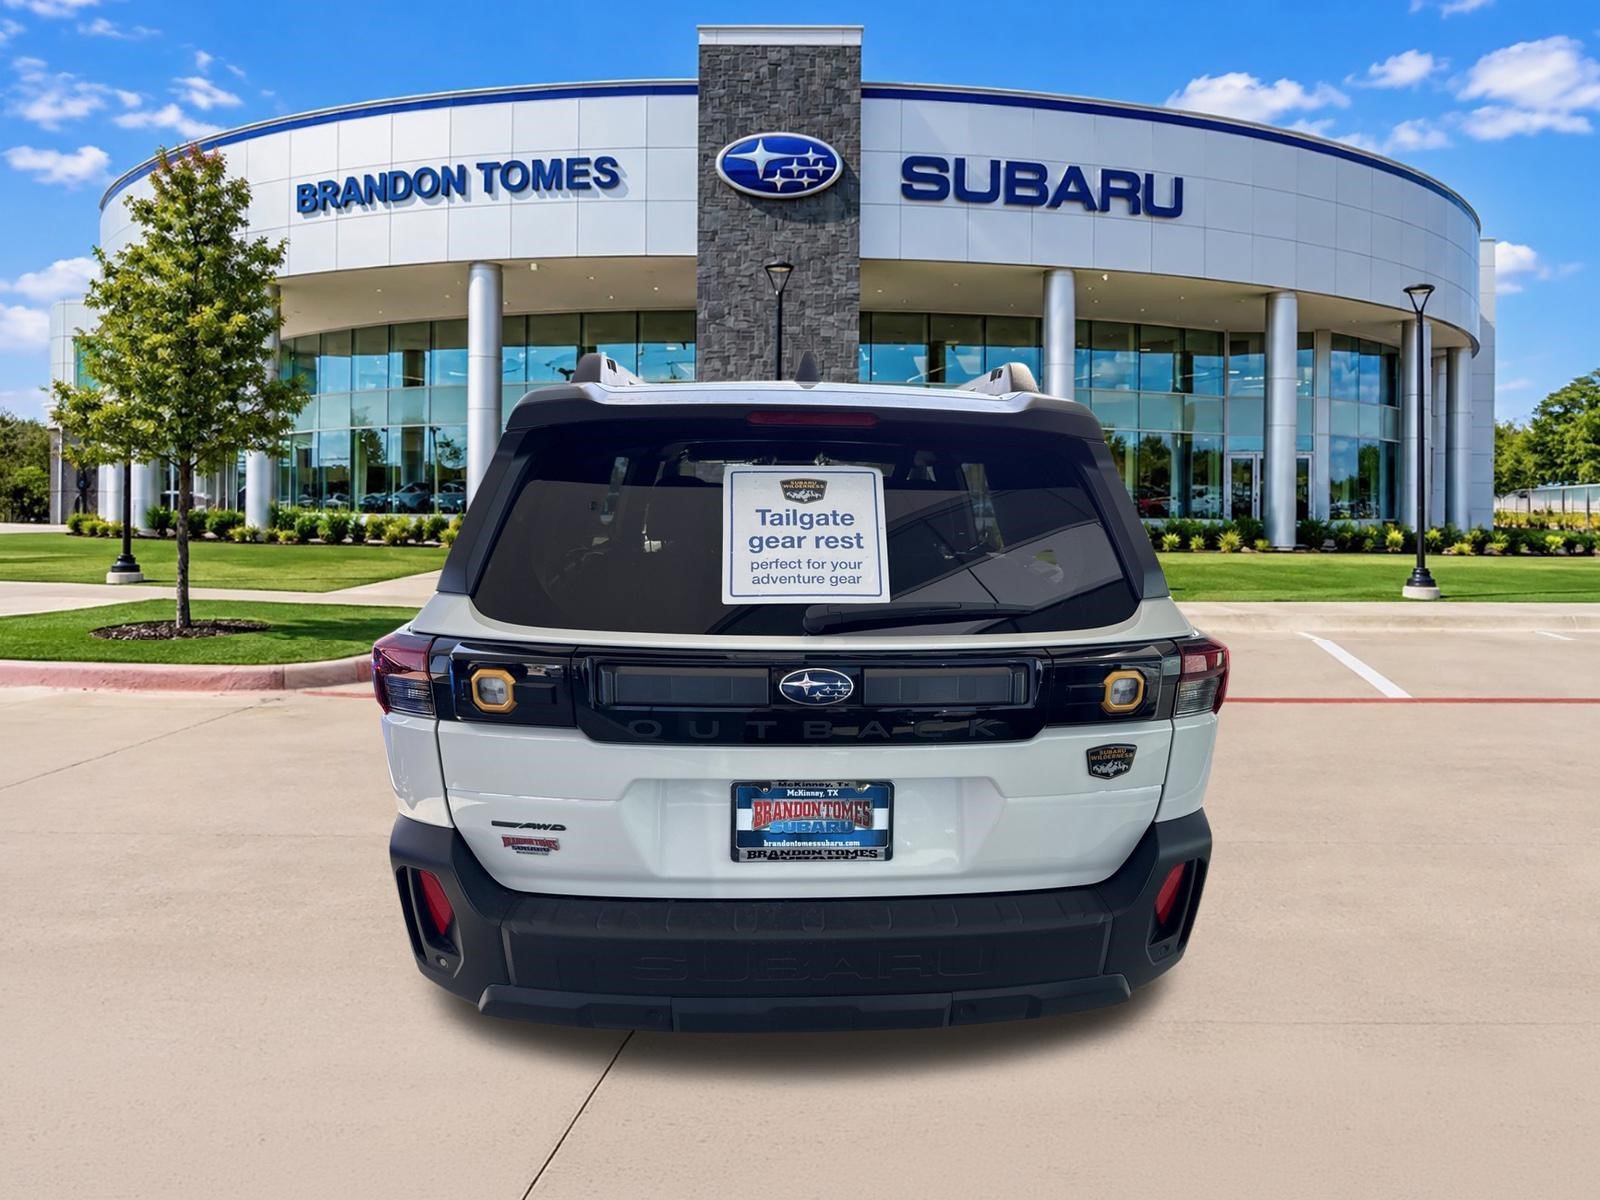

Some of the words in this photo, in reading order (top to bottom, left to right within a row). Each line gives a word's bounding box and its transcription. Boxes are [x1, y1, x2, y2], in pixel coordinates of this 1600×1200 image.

[296, 165, 466, 214] BRANDON
[476, 156, 620, 194] TOMES
[901, 155, 1183, 218] SUBARU
[755, 509, 855, 530] Tailgate
[748, 535, 807, 554] gear
[815, 532, 864, 549] rest
[750, 558, 801, 572] perfect
[807, 559, 827, 570] for
[831, 561, 863, 573] your
[751, 573, 825, 585] adventure
[829, 575, 862, 587] gear
[627, 718, 1002, 740] OUTBACK
[786, 789, 825, 798] McKinney,
[827, 789, 839, 797] TX
[753, 800, 821, 830] BRANDON
[822, 800, 873, 828] TOMES
[519, 823, 566, 831] AWD
[769, 820, 855, 834] SUBARU
[763, 839, 861, 848] brandontomessubaru.com
[747, 849, 822, 860] BRANDON
[823, 849, 878, 859] TOMES
